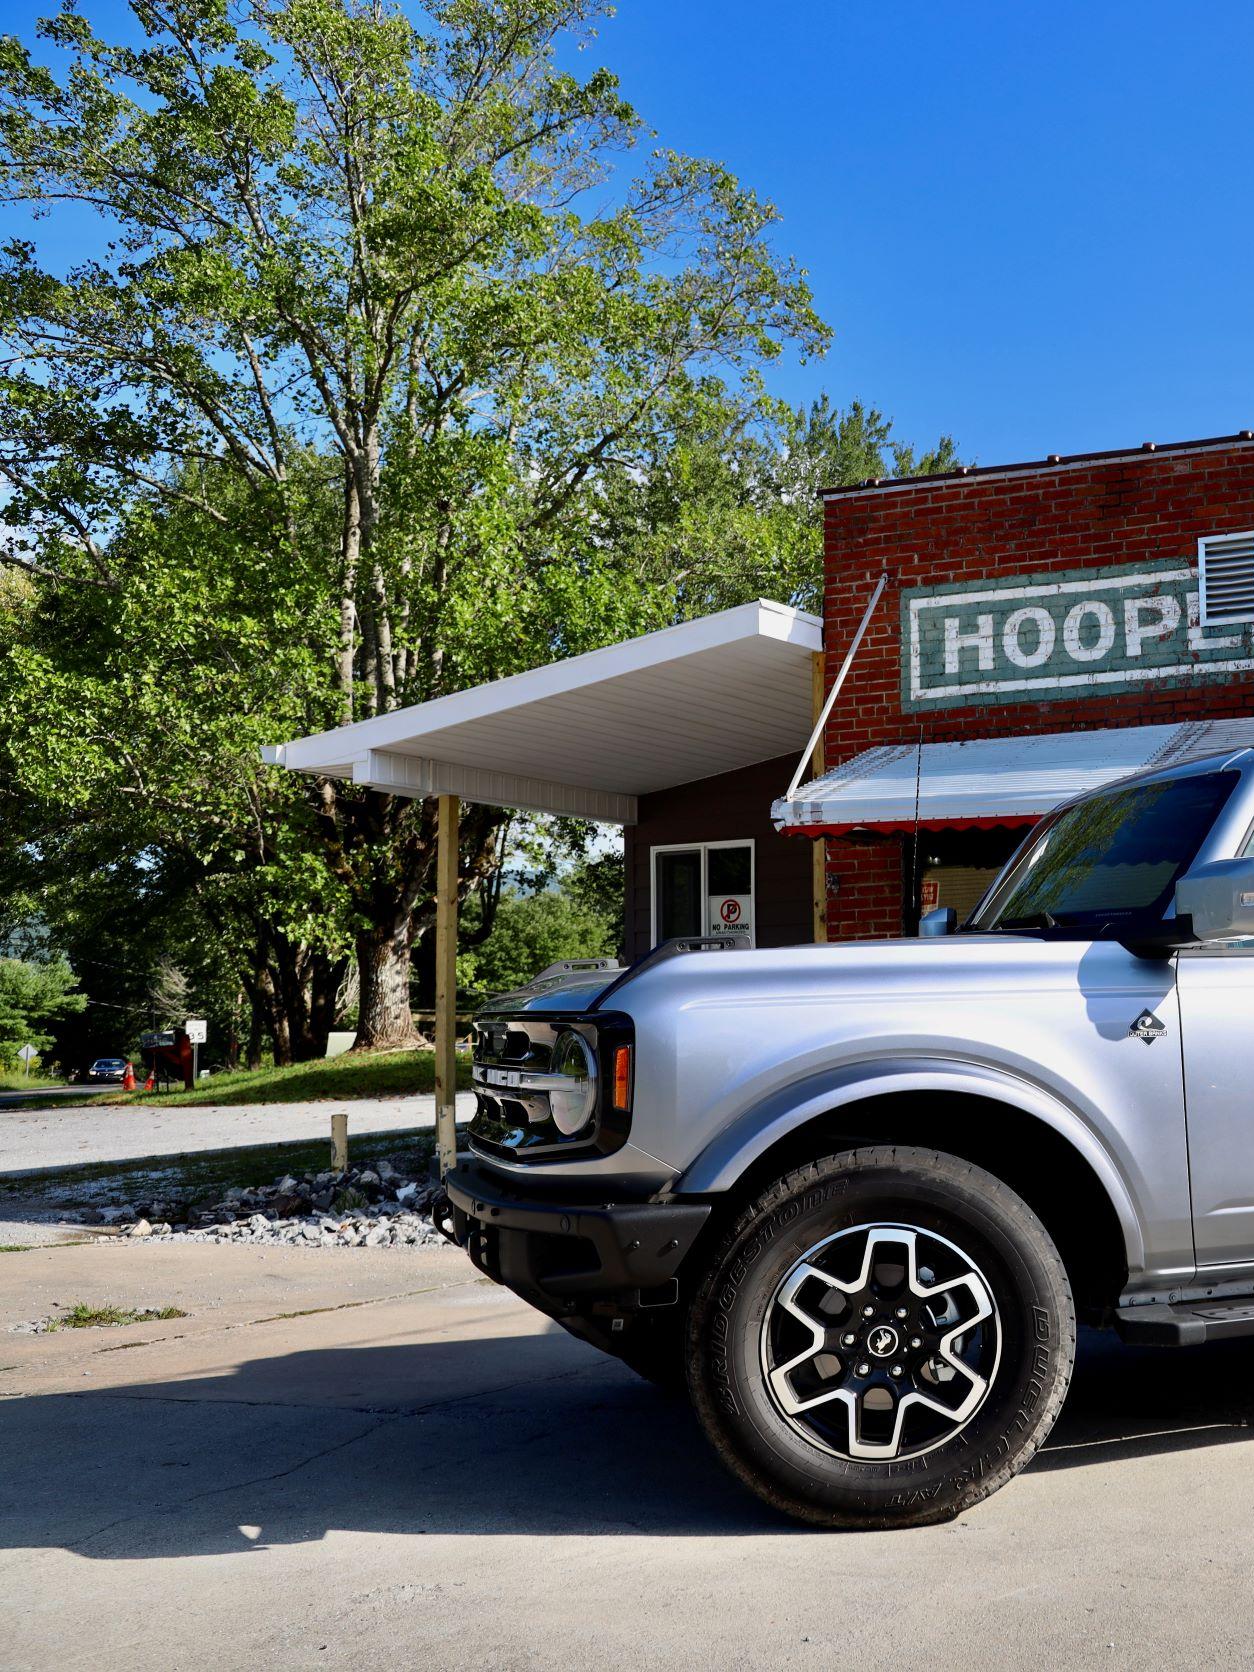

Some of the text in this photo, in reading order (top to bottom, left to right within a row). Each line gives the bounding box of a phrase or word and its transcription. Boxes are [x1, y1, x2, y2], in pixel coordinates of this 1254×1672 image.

[712, 923, 749, 931] NO PARKING
[189, 1032, 204, 1040] 35
[711, 1179, 849, 1416] BRIDGESTONE
